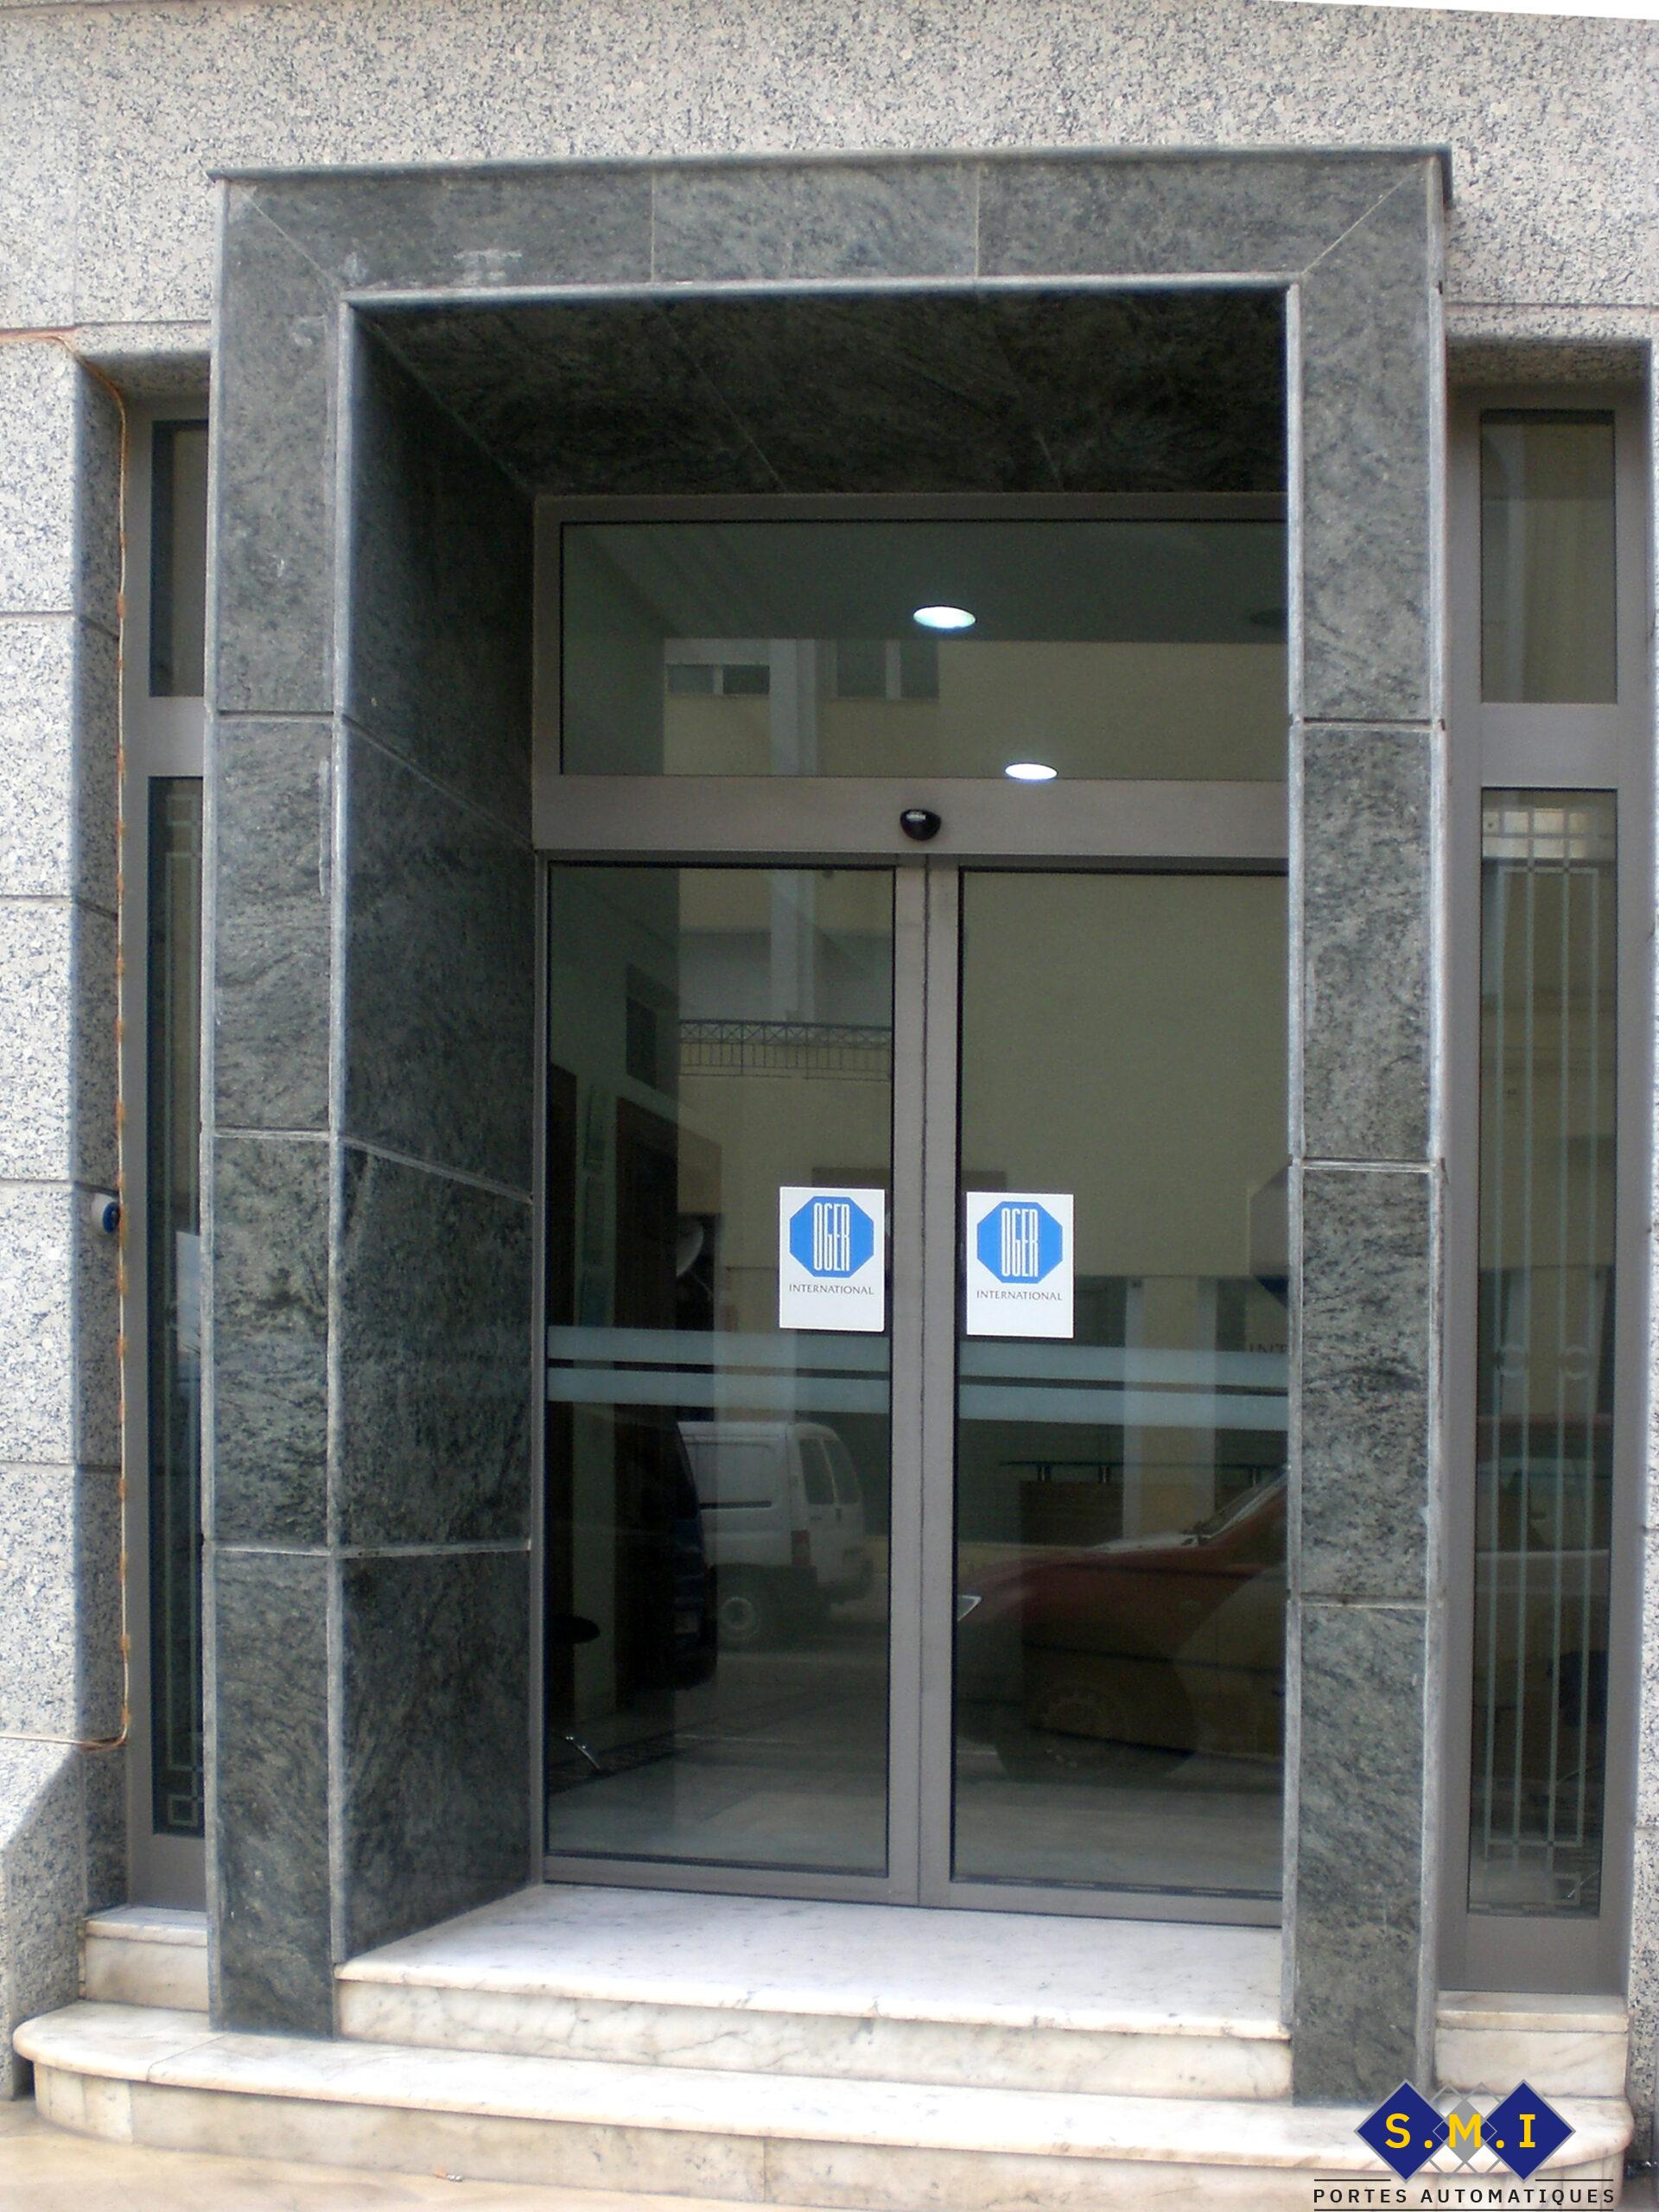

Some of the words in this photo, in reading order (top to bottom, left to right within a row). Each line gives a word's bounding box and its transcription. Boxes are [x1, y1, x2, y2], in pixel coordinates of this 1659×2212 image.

[812, 1202, 851, 1272] OGER
[1001, 1207, 1039, 1277] OGER
[789, 1284, 874, 1295] INTERNATIONAL
[976, 1289, 1063, 1301] INTERNATIONAL
